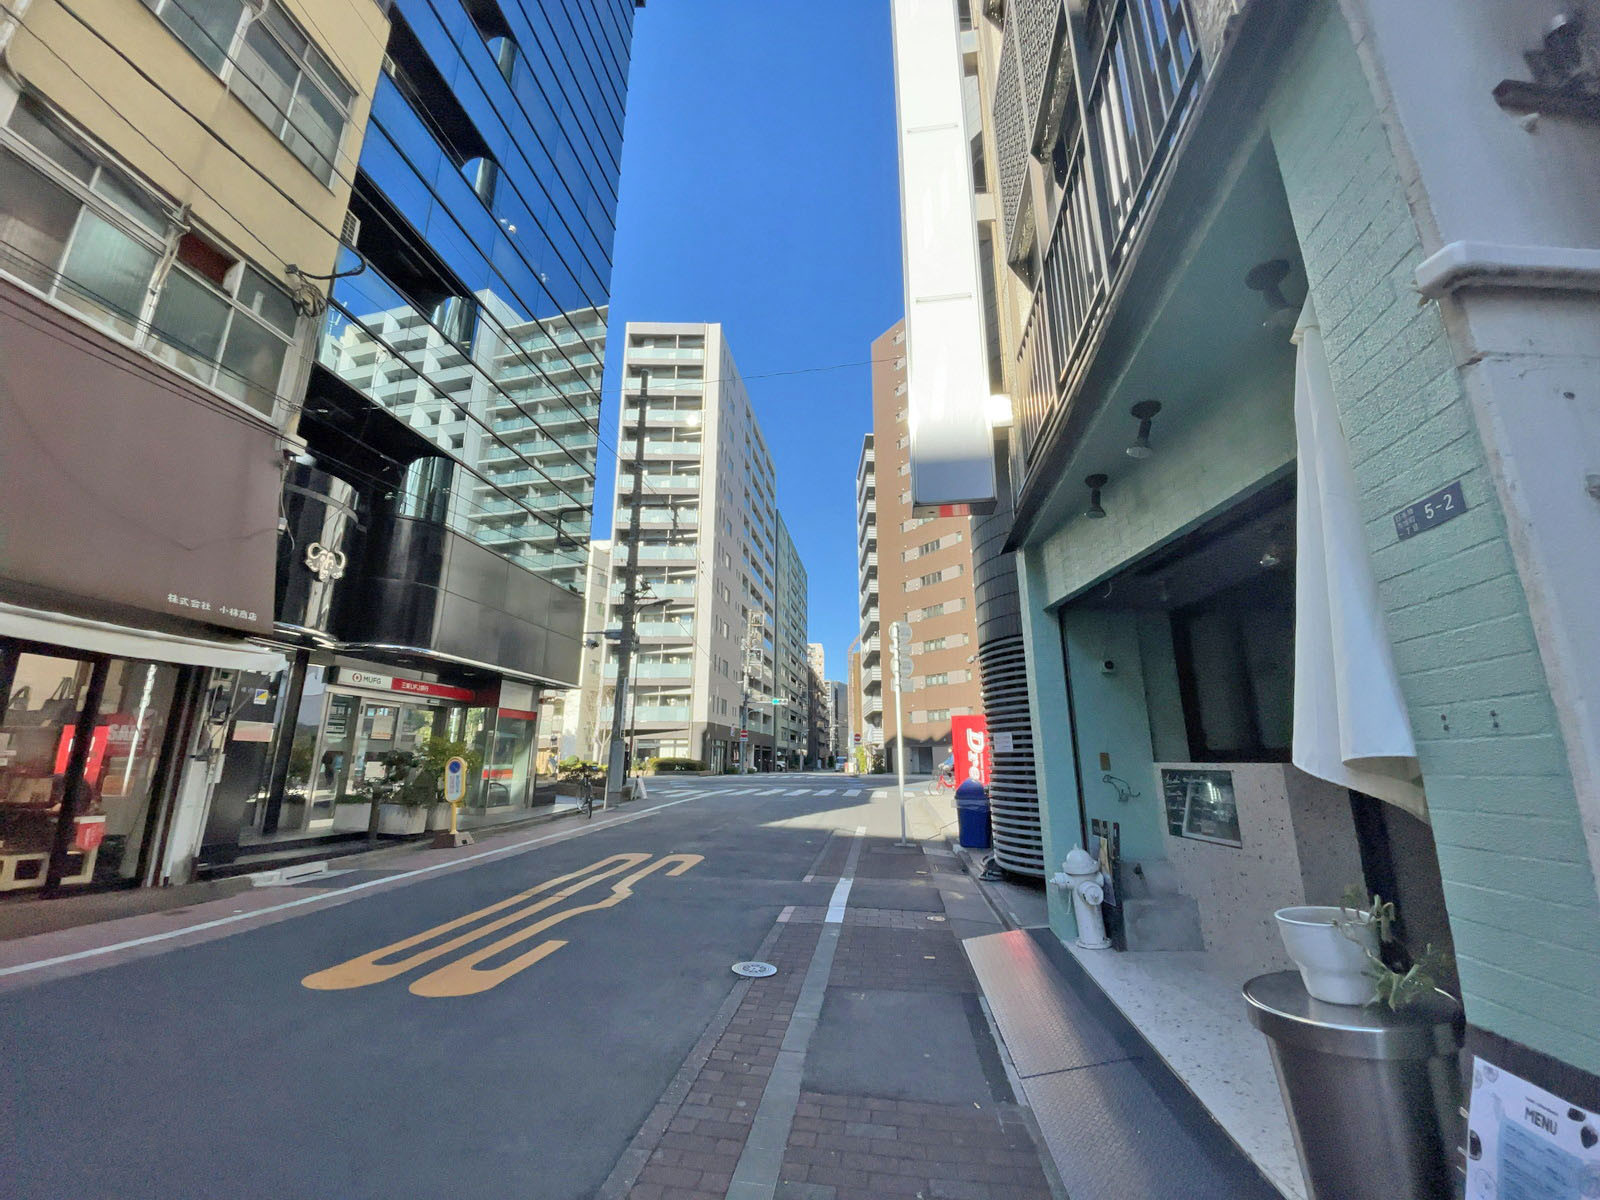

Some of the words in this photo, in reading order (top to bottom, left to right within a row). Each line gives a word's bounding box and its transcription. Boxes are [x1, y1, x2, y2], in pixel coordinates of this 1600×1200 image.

[1424, 494, 1454, 519] 5-2
[167, 593, 211, 611] 株式会社
[363, 676, 382, 685] MUFG
[966, 727, 984, 782] Dre
[1525, 1107, 1558, 1136] MENU
